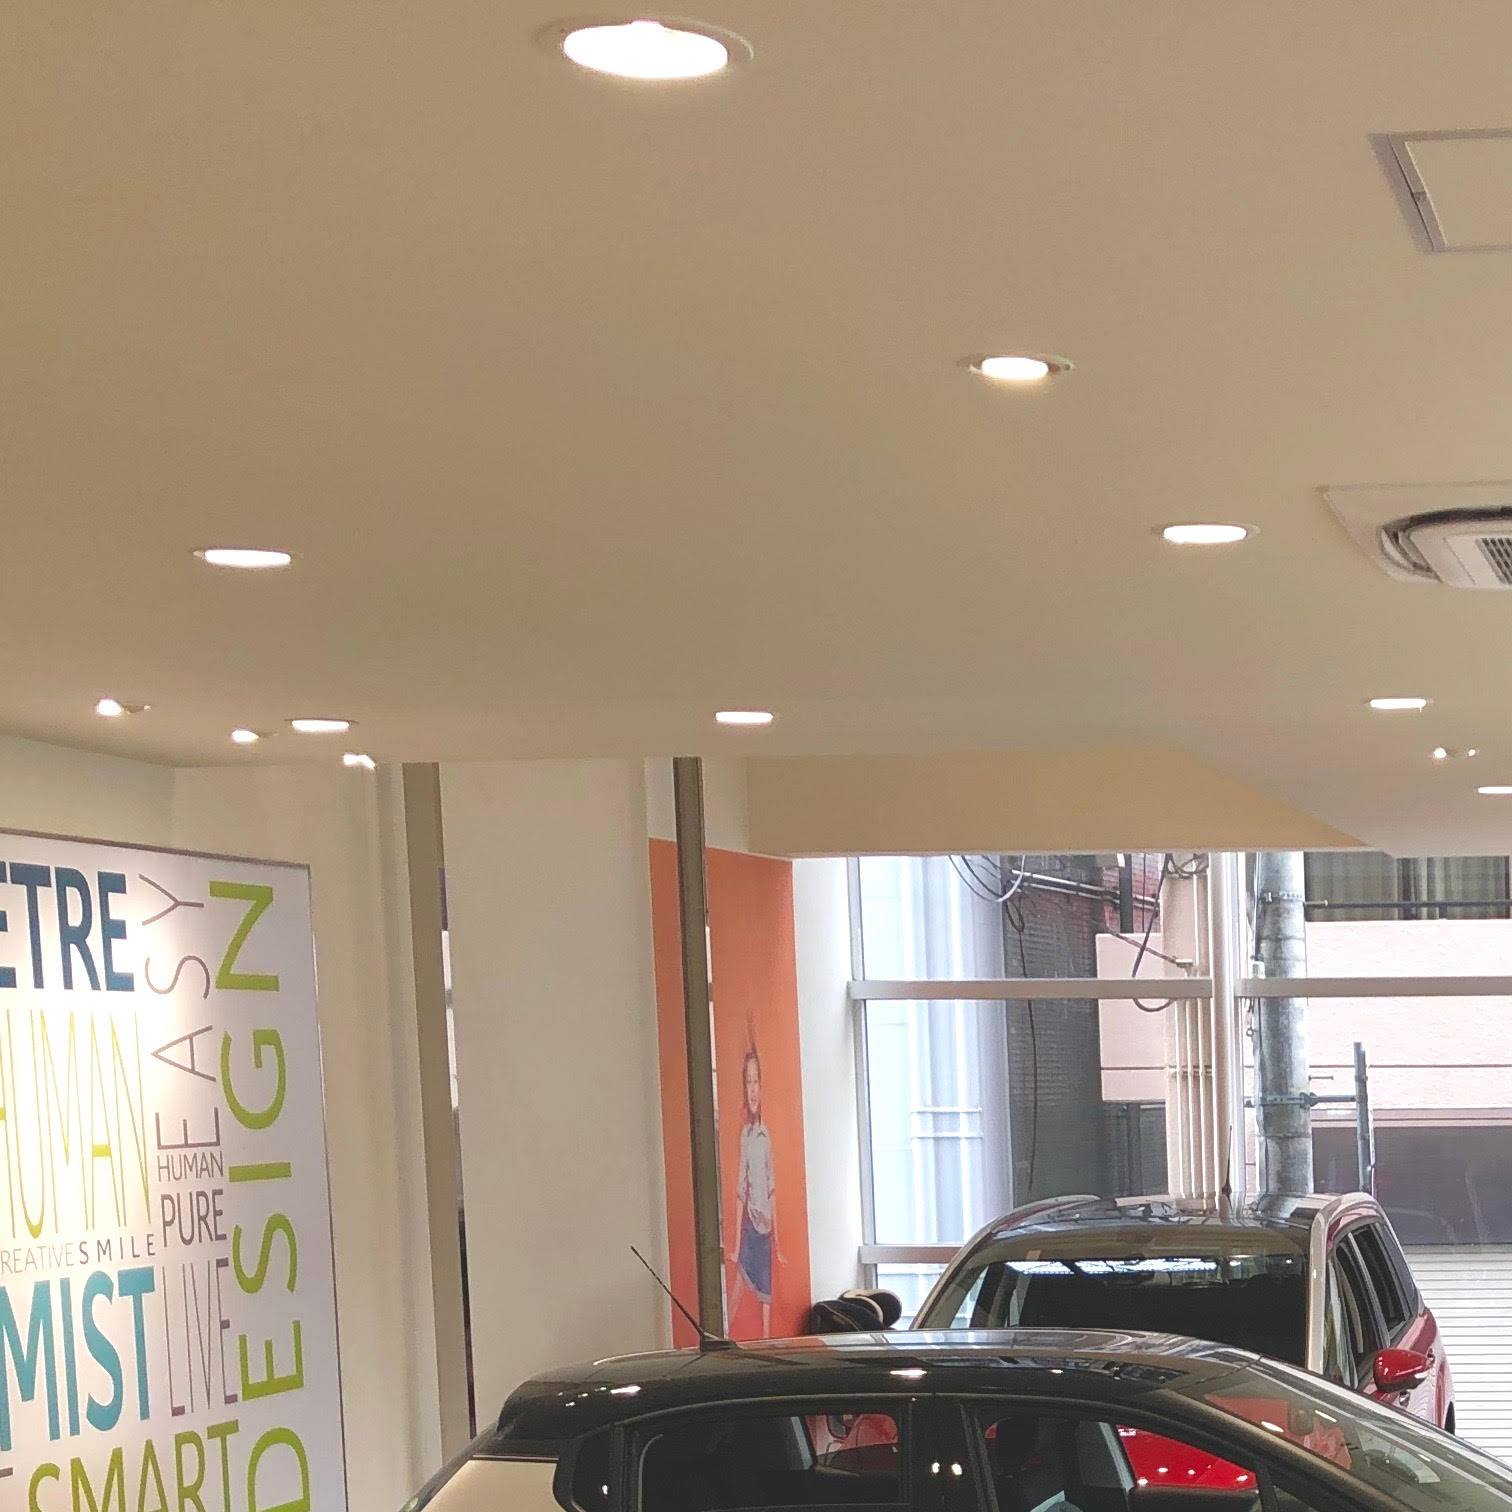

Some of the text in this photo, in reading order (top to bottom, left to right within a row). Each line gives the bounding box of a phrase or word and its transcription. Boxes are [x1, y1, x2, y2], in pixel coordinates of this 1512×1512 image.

[138, 872, 221, 1150] EASY
[157, 1150, 224, 1182] HUMAN
[160, 1188, 227, 1247] PURE
[79, 1233, 156, 1265] SMILE
[161, 1258, 239, 1418] LIVE
